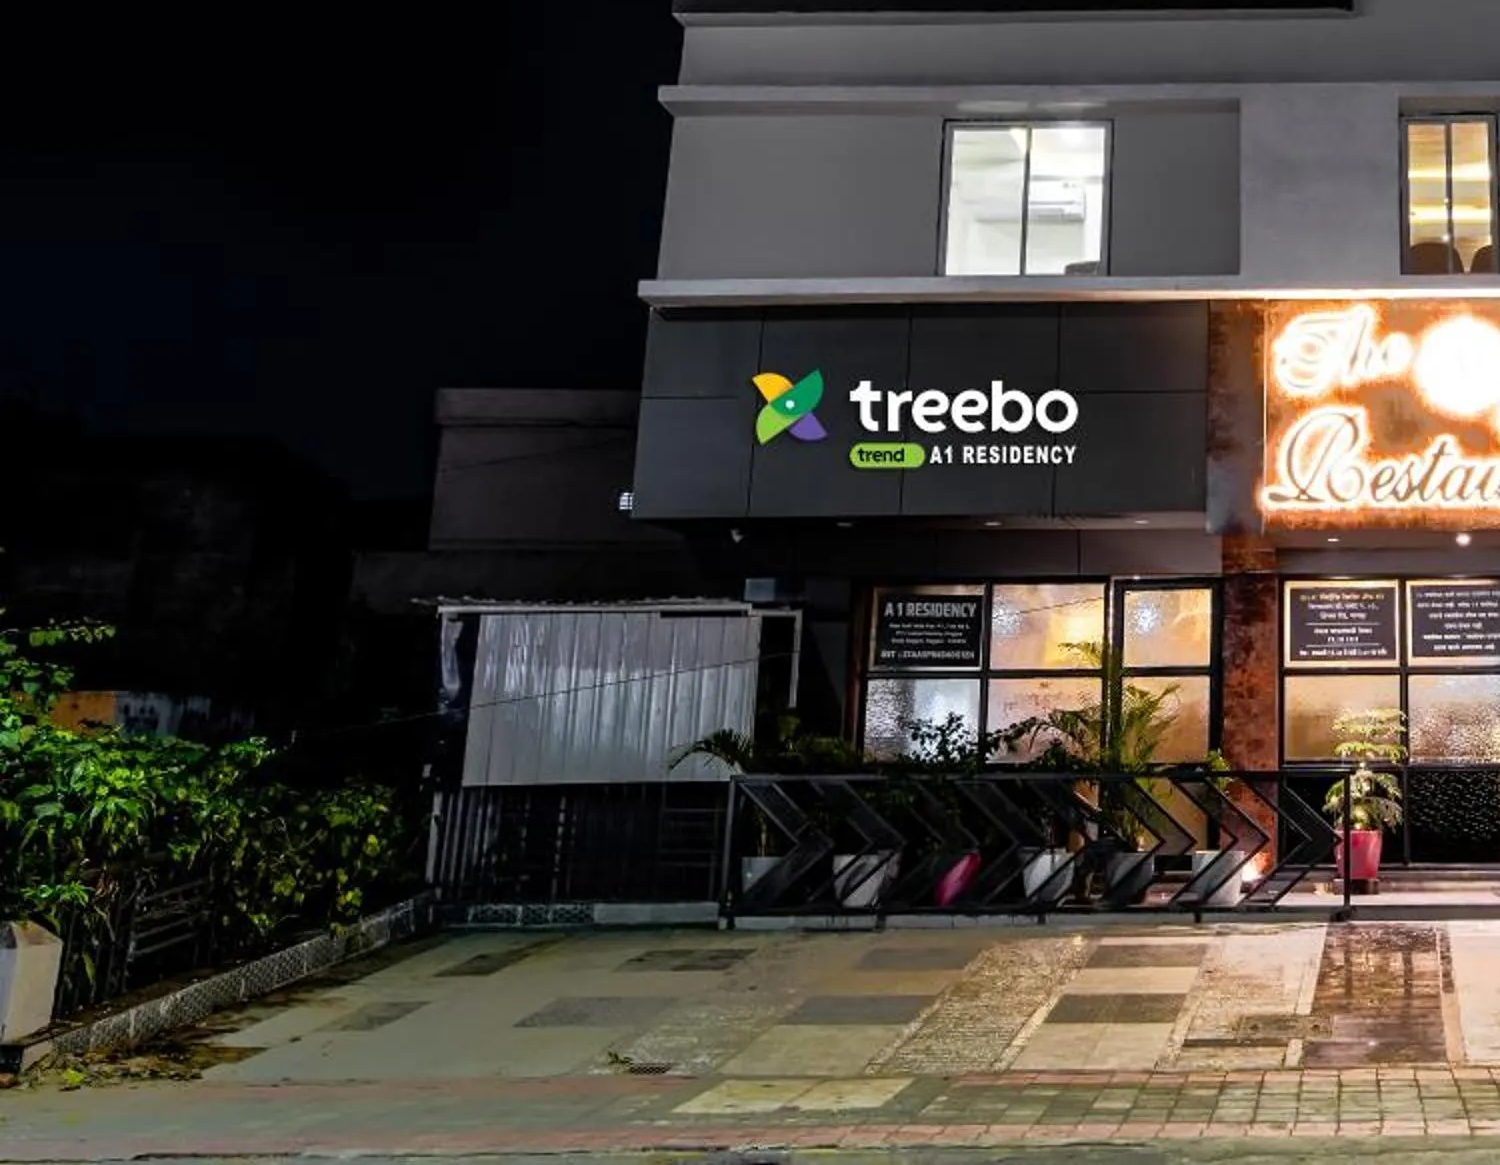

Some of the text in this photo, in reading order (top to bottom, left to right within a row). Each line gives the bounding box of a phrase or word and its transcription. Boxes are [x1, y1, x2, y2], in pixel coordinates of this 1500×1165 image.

[849, 380, 1079, 433] treebo
[857, 447, 905, 463] trend
[929, 446, 1077, 464] A1 RESIDENCY
[905, 602, 977, 617] RESIDENCY
